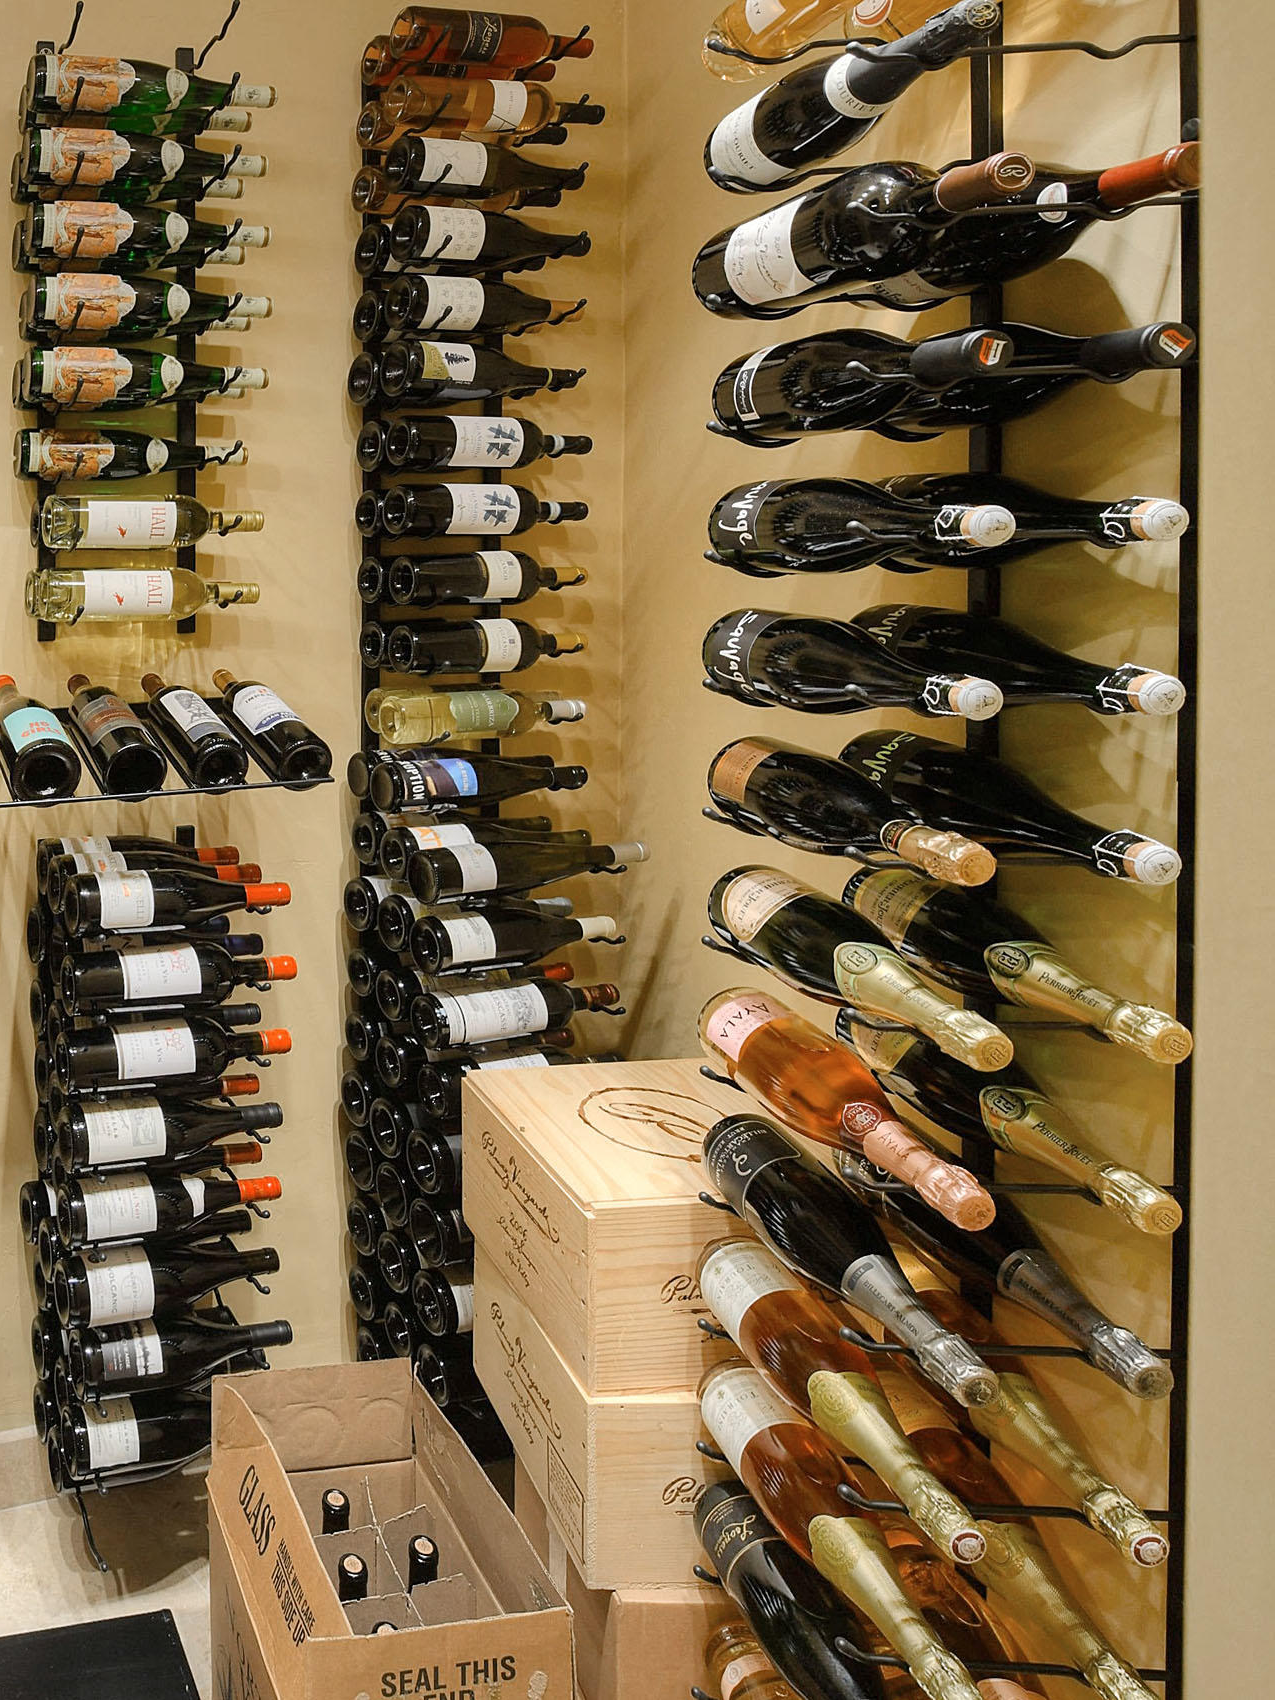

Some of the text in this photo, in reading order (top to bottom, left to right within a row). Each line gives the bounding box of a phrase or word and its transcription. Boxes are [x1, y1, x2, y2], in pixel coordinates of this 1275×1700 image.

[149, 506, 166, 540] HALL
[718, 480, 768, 547] auvage
[146, 574, 163, 608] HALL
[713, 608, 759, 695] Sauvage
[399, 760, 426, 801] RUPTION
[862, 731, 916, 790] Sauva
[719, 1001, 771, 1039] AYALA
[877, 1131, 910, 1162] AYALA
[660, 1274, 703, 1305] Pal
[238, 1464, 276, 1557] GLASS
[662, 1476, 707, 1506] Pal
[271, 1559, 306, 1647] THIS SIDE UP
[278, 1537, 316, 1633] HANDLE WITH CARE
[381, 1654, 517, 1699] SEAL THIS
